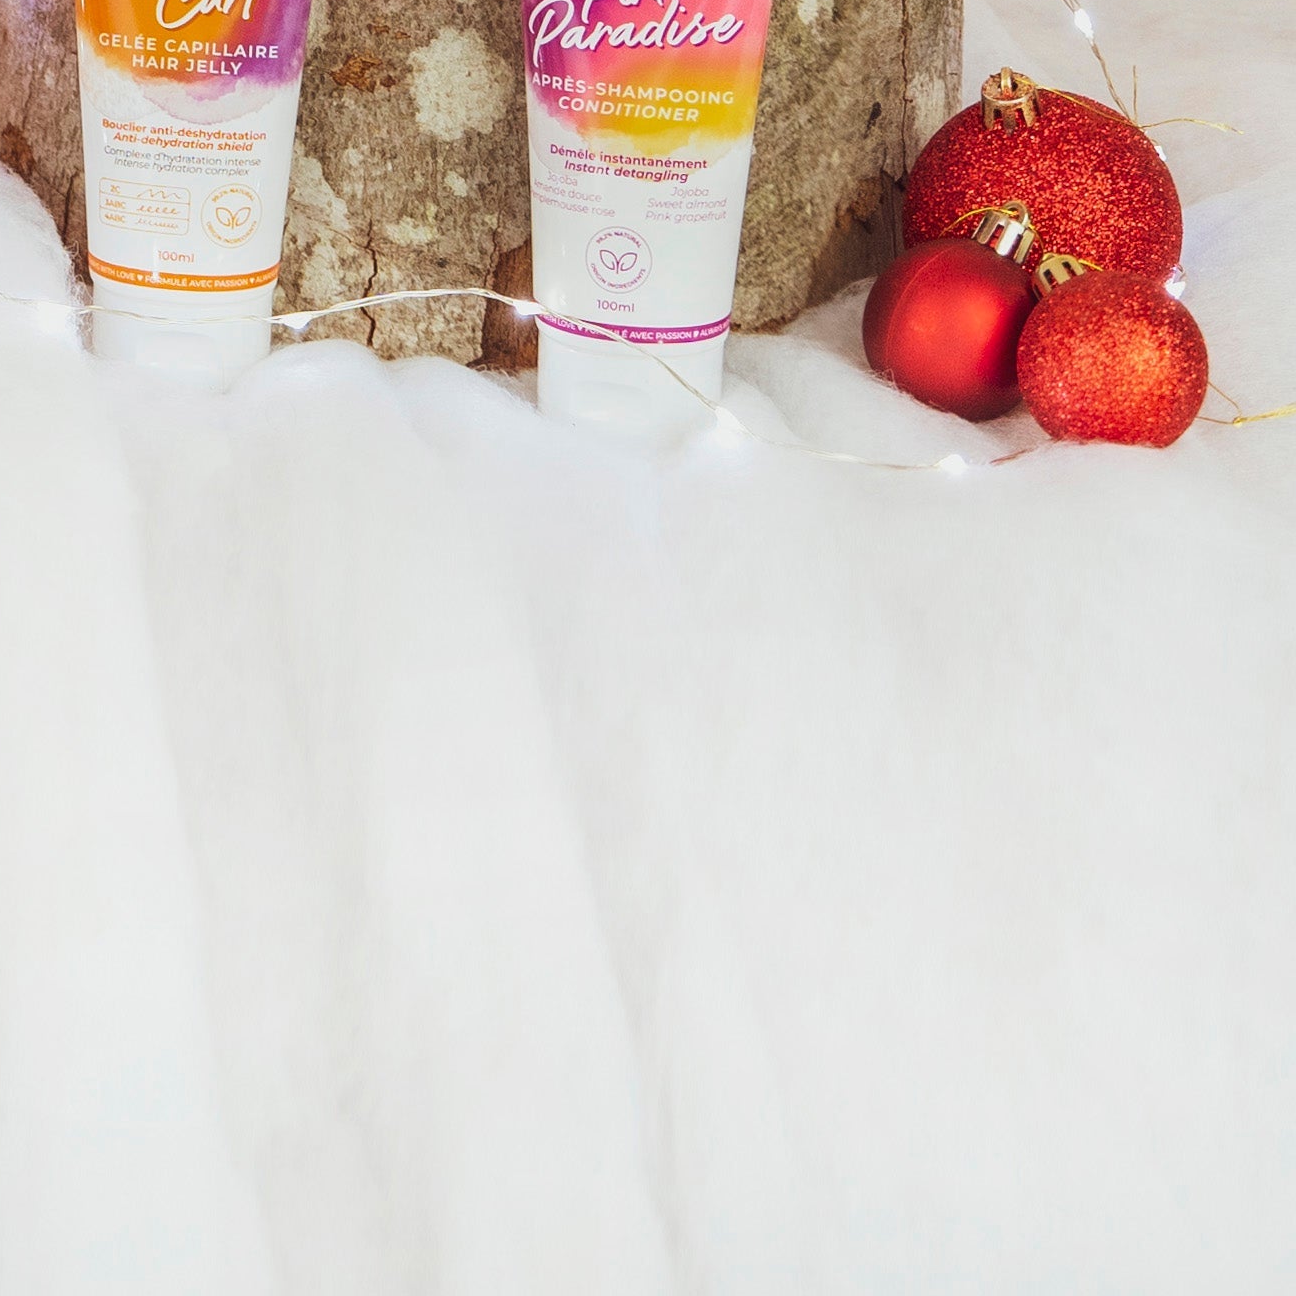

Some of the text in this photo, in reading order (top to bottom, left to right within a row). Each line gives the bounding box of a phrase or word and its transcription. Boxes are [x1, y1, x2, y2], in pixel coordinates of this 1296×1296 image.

[99, 33, 279, 58] GELÉE CAPILLAIRE
[133, 55, 242, 75] HAIR JELLY
[532, 72, 734, 104] APRÈS-SHAMPOOING
[558, 96, 699, 122] CONDITIONER
[102, 119, 266, 140] Bouclier anti-déshydratation
[113, 132, 253, 151] Anti-dehydration shield
[104, 146, 261, 166] Complexe d'hydratation intense
[550, 144, 708, 169] Démêle instantanément
[565, 160, 689, 183] Instant detangling
[158, 251, 194, 263] 100ml
[190, 278, 248, 287] AVEC PASSION
[597, 300, 634, 312] 100ml
[629, 331, 653, 339] AVEC
